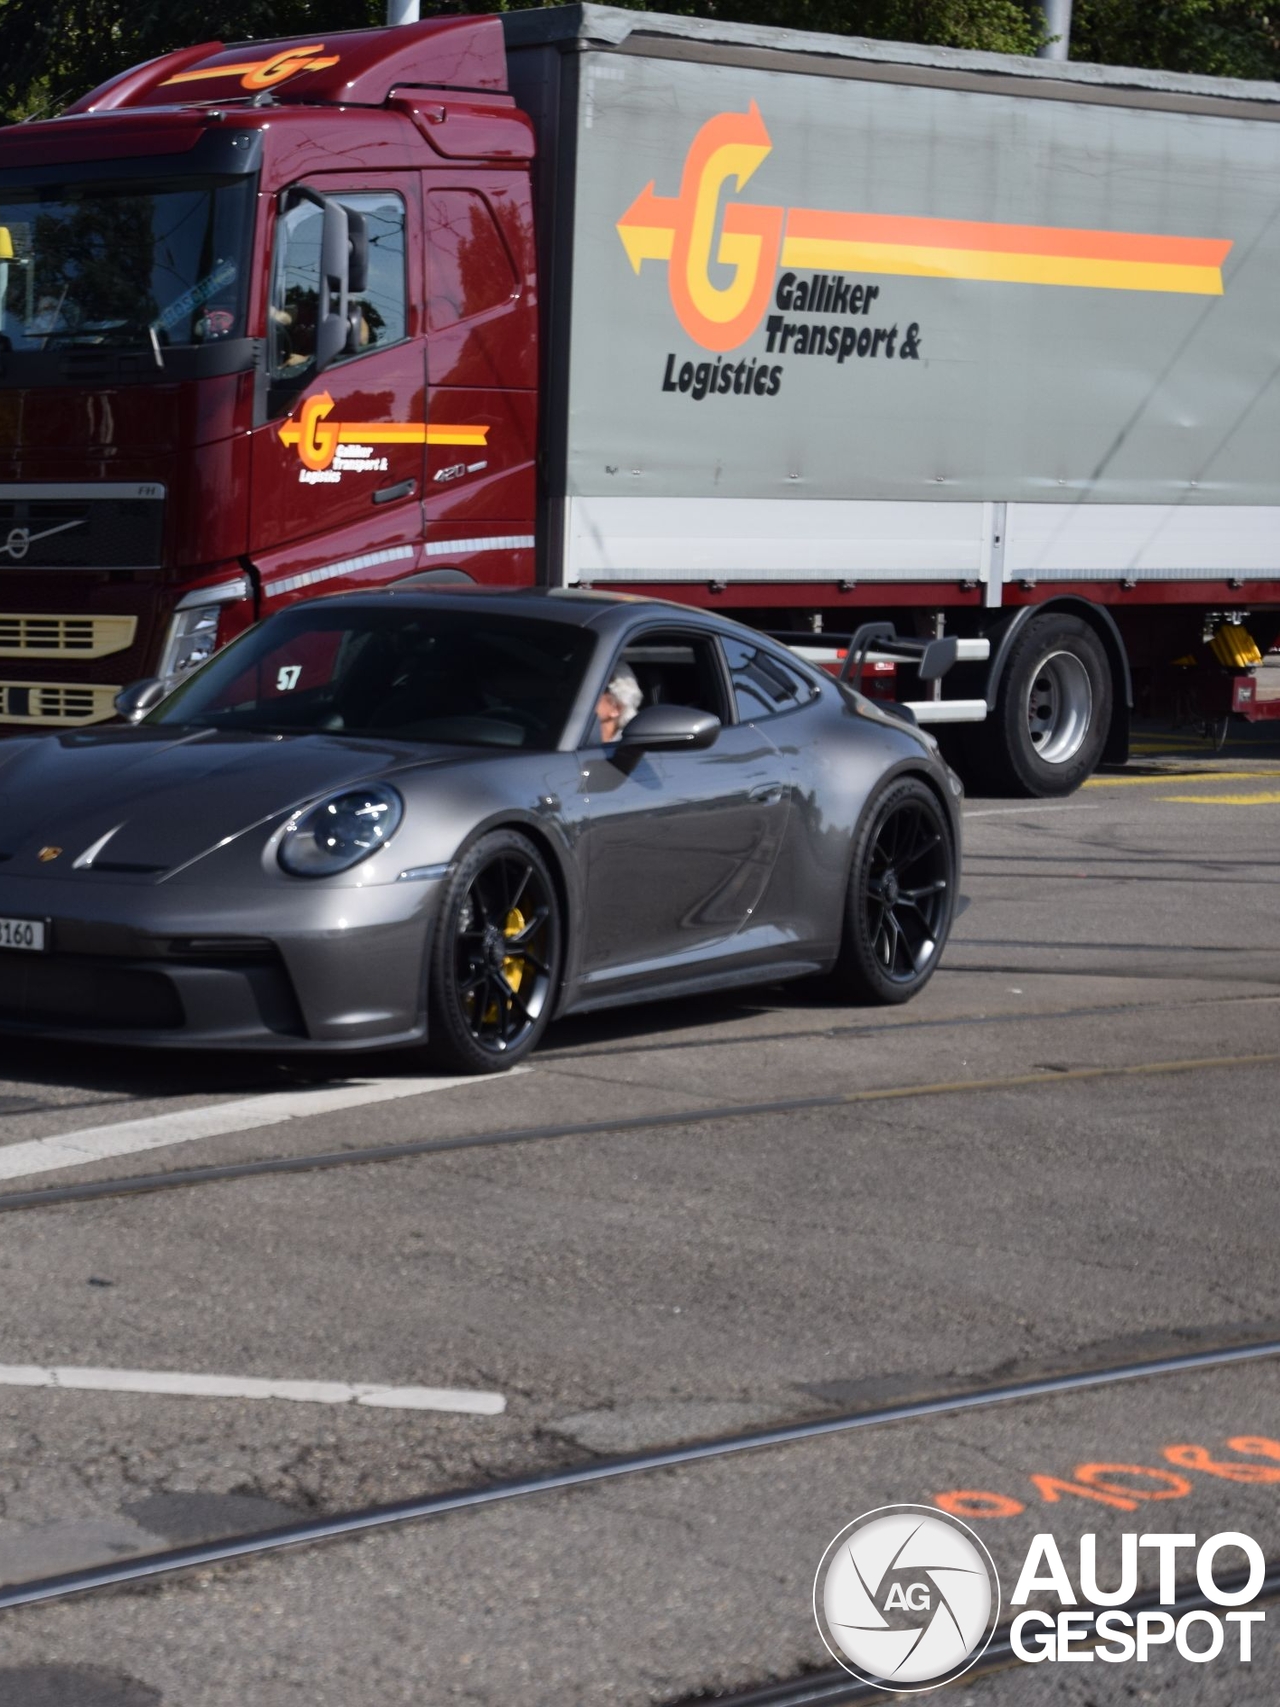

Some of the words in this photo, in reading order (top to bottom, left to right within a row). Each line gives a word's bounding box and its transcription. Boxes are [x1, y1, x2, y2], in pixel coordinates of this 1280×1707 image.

[776, 272, 880, 315] Galliker
[766, 315, 898, 363] Transport
[900, 322, 922, 360] &
[662, 354, 784, 400] Logistics
[138, 487, 155, 496] FH
[276, 665, 302, 691] 57
